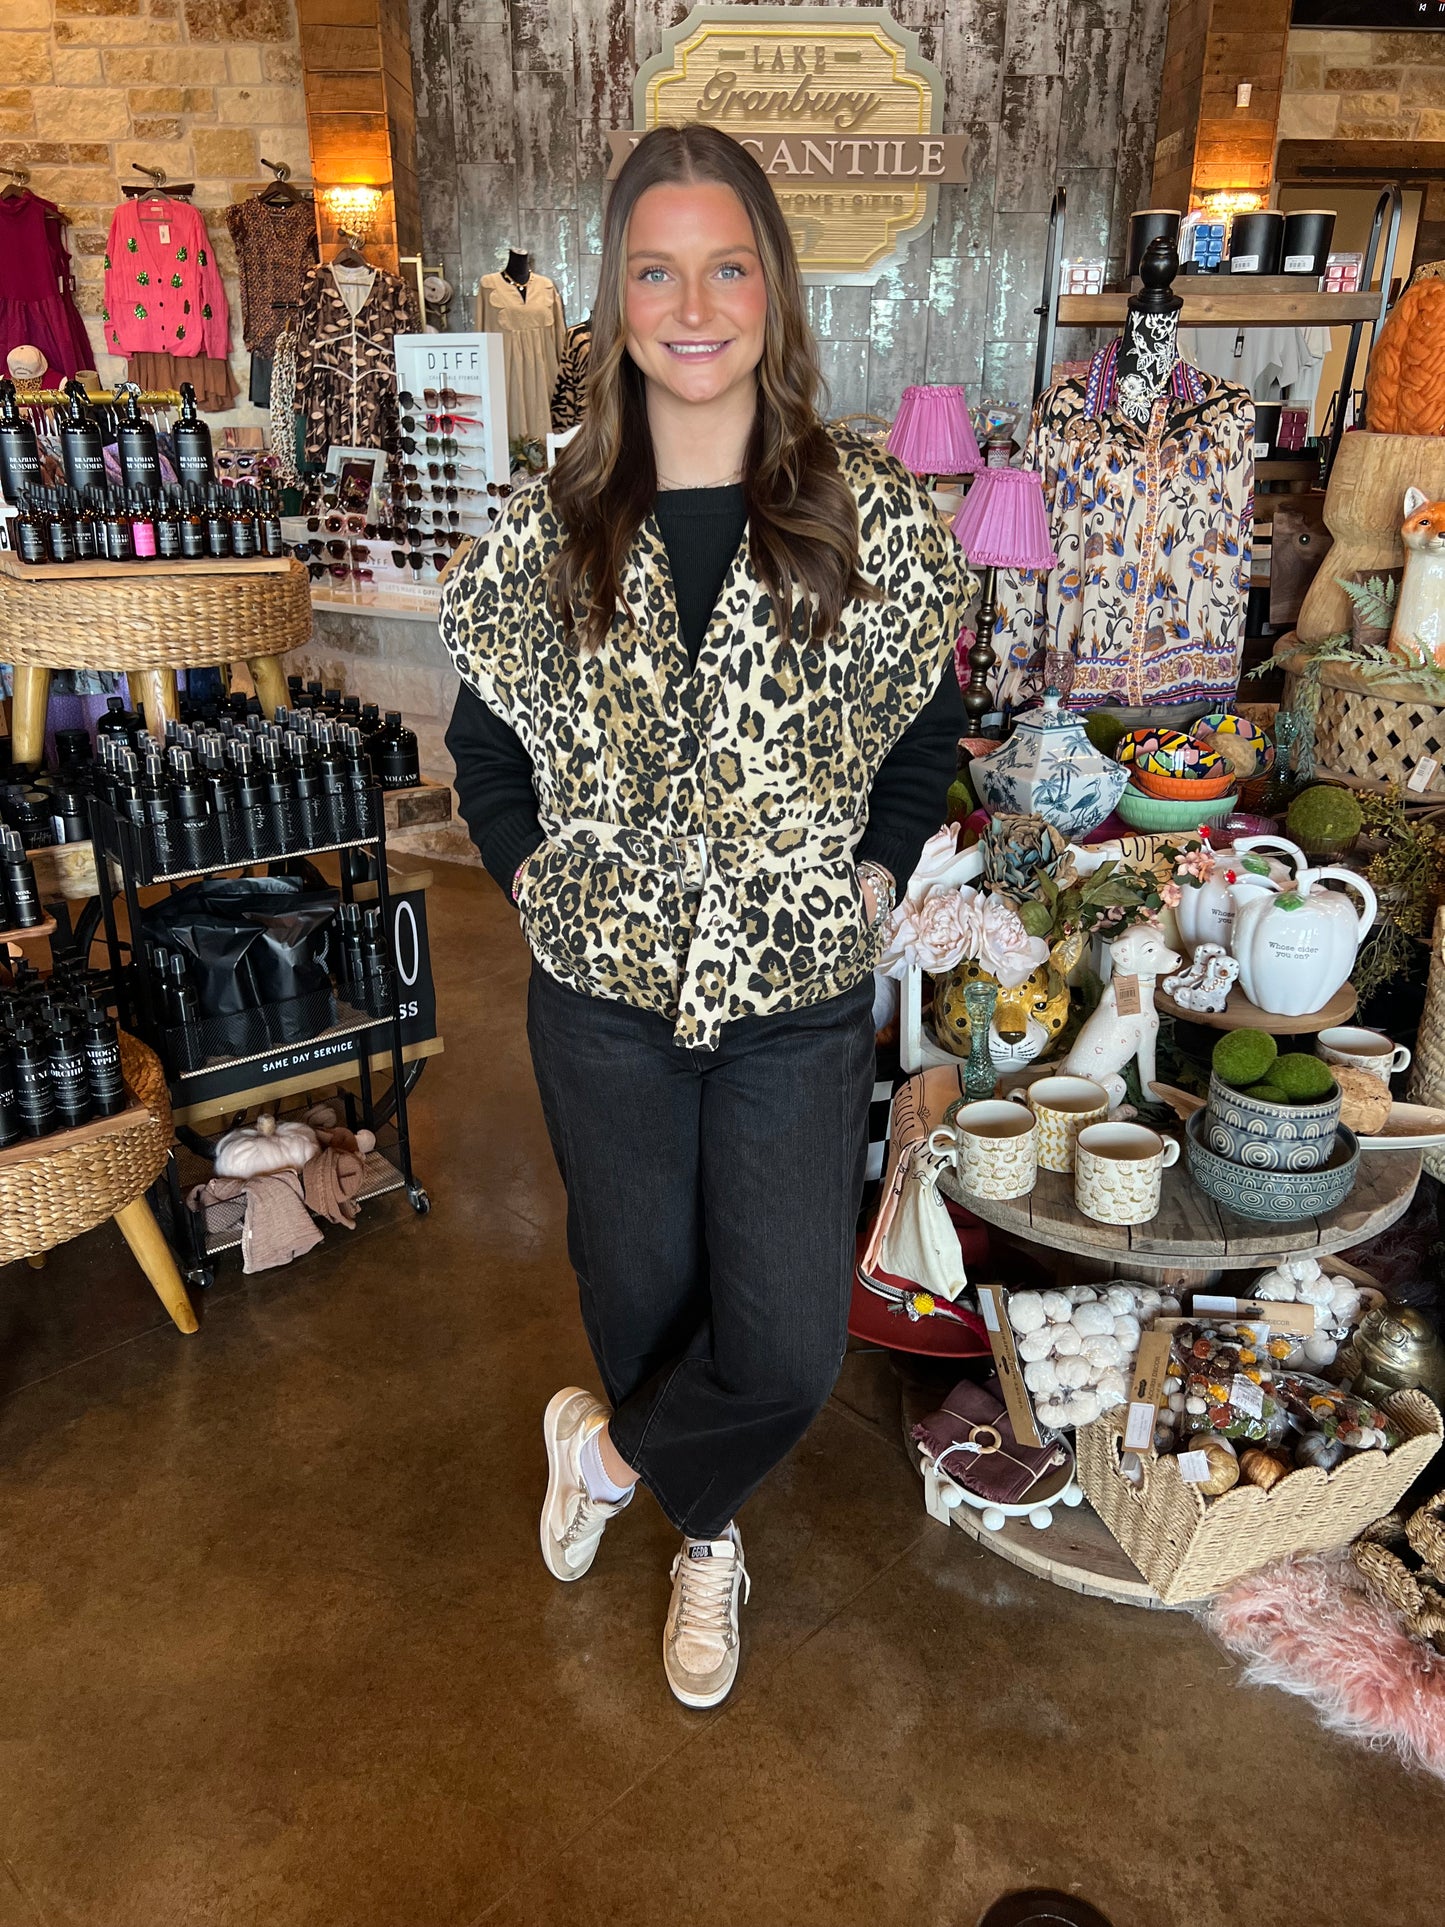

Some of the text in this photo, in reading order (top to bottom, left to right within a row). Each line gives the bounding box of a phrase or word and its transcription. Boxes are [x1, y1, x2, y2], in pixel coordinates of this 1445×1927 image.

[754, 45, 826, 69] LAKE
[697, 67, 882, 128] Granbury
[628, 137, 946, 176] CANTILE
[428, 352, 478, 370] DIFF
[1211, 908, 1235, 918] Whose
[1268, 941, 1319, 954] Whose cider
[262, 1041, 354, 1073] SAME DAY SERVICE
[50, 1066, 83, 1078] ORCHID
